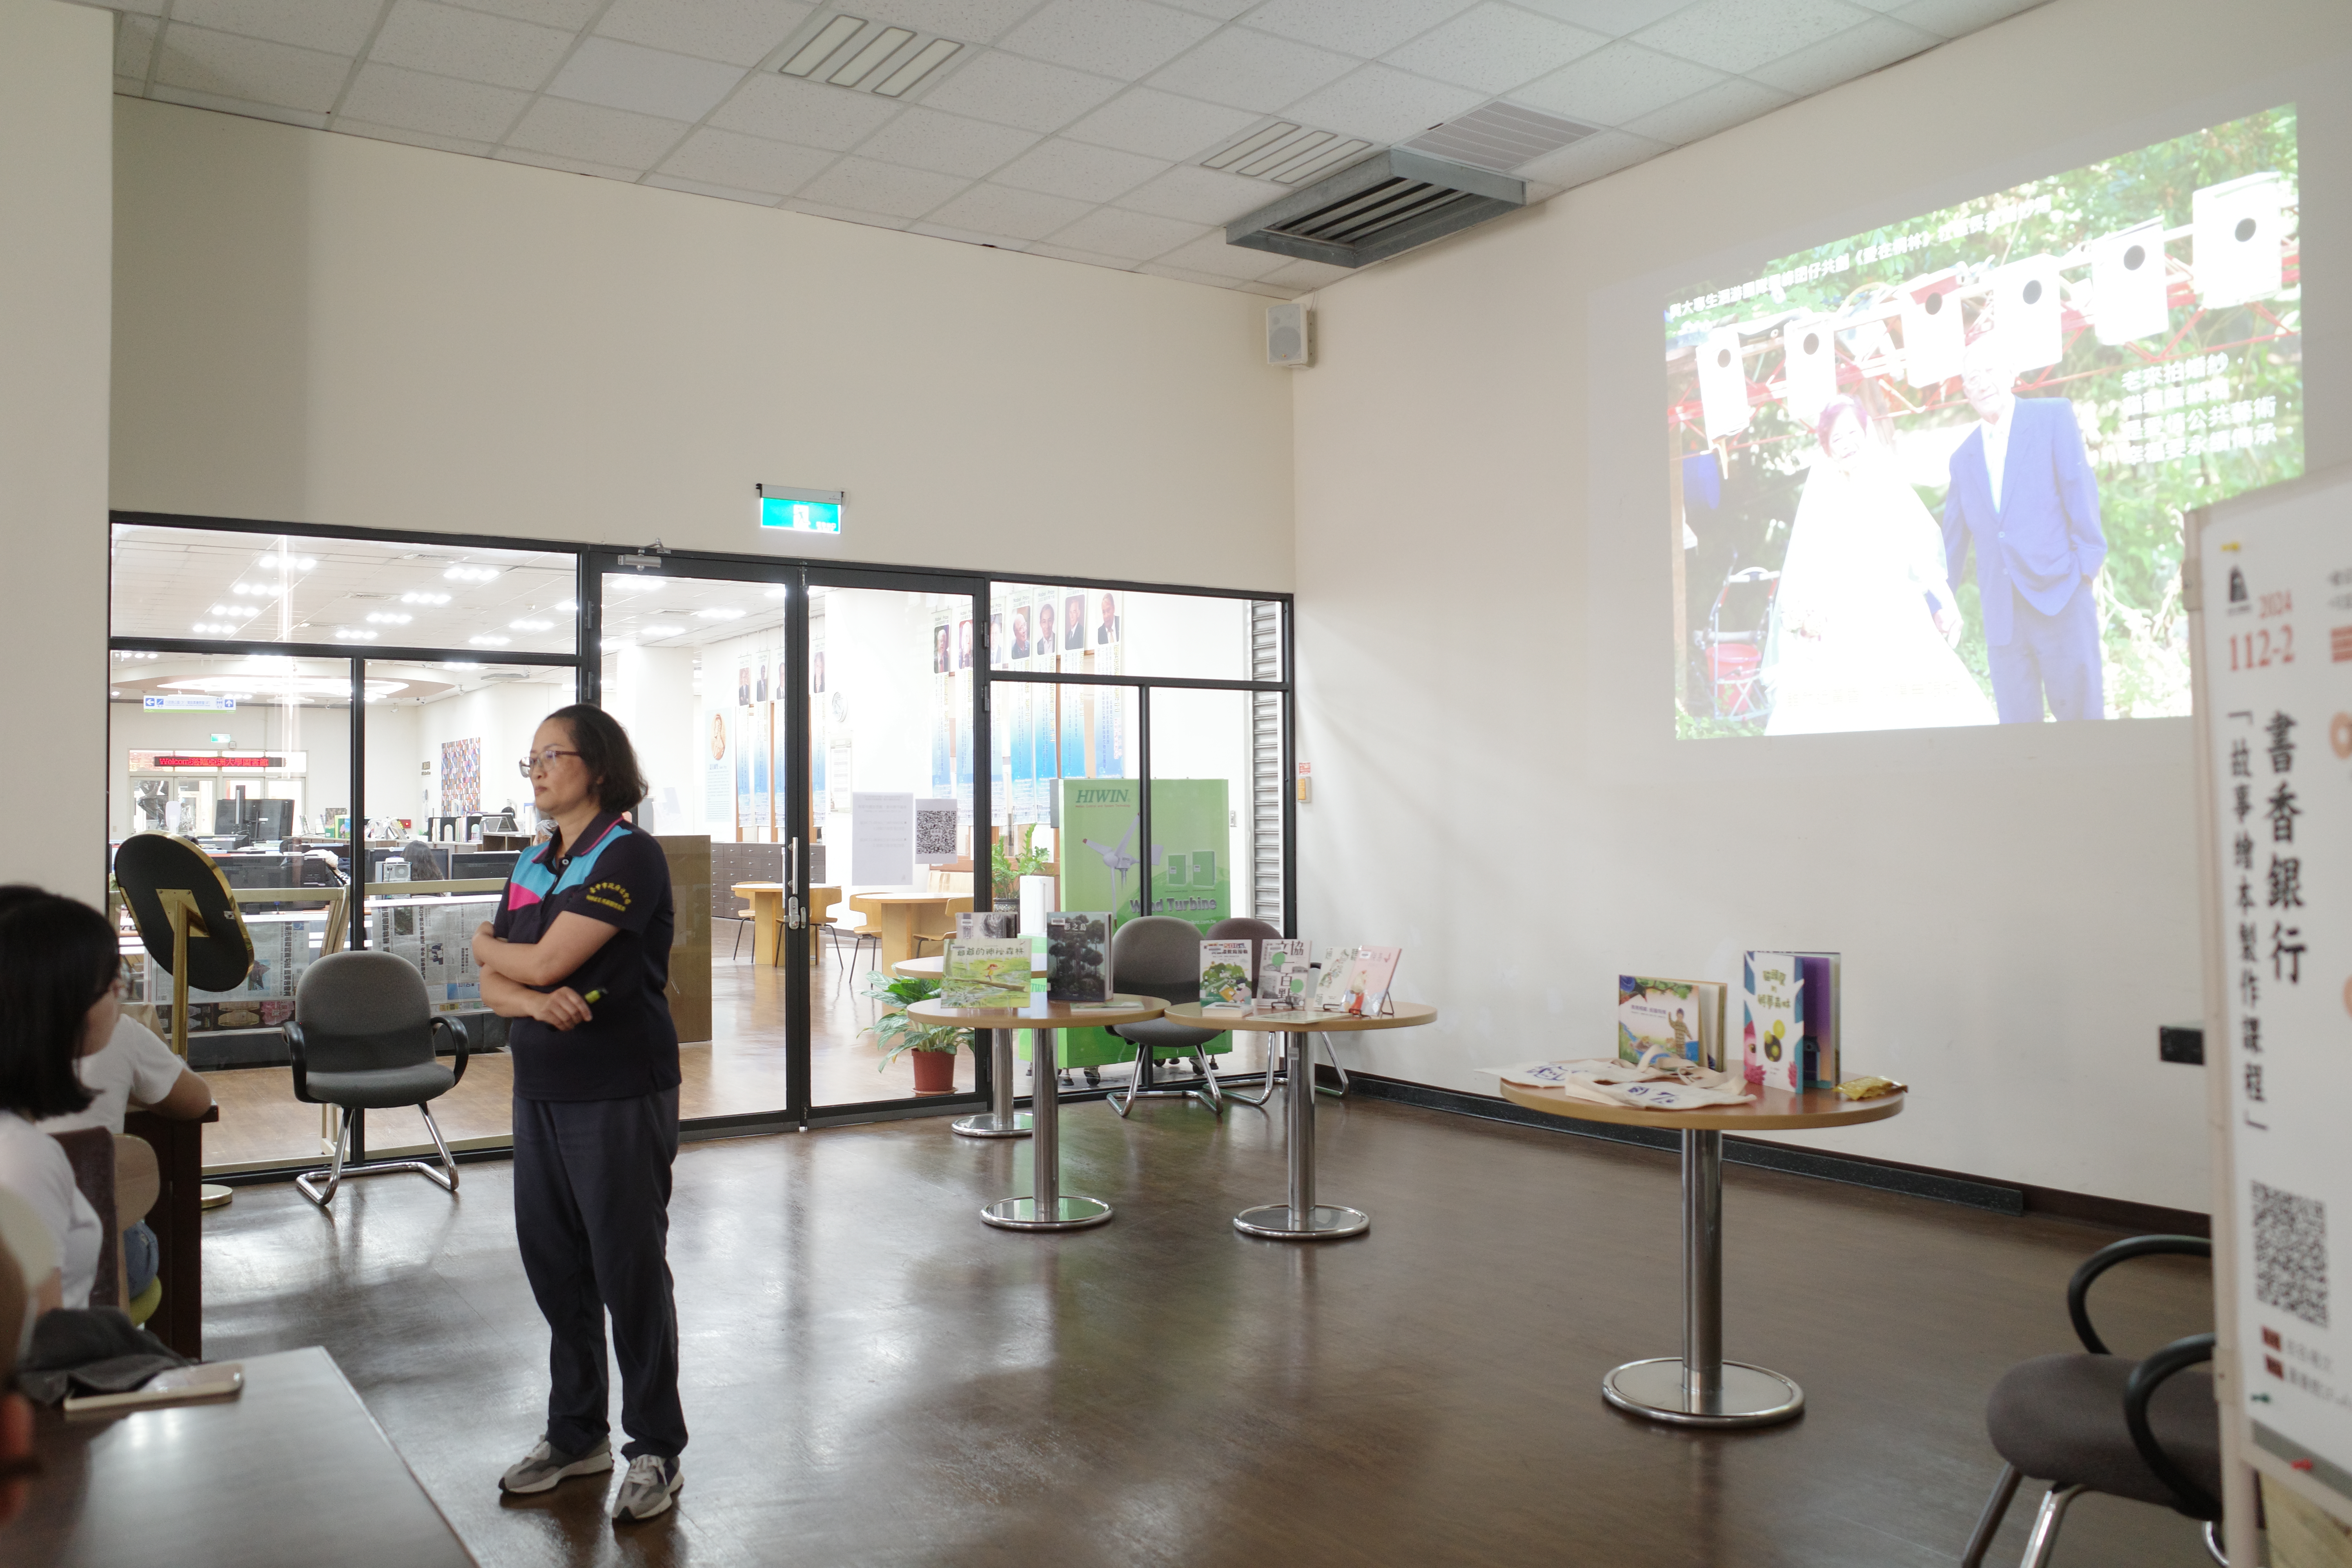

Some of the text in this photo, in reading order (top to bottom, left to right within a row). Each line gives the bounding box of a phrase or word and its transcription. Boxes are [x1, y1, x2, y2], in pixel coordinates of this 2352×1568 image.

[2260, 590, 2293, 619] 2024
[2230, 625, 2294, 671] 112-2
[1076, 789, 1129, 803] HIWIN
[2264, 710, 2307, 984] 書香銀行
[1129, 896, 1217, 913] Wnd Turbine
